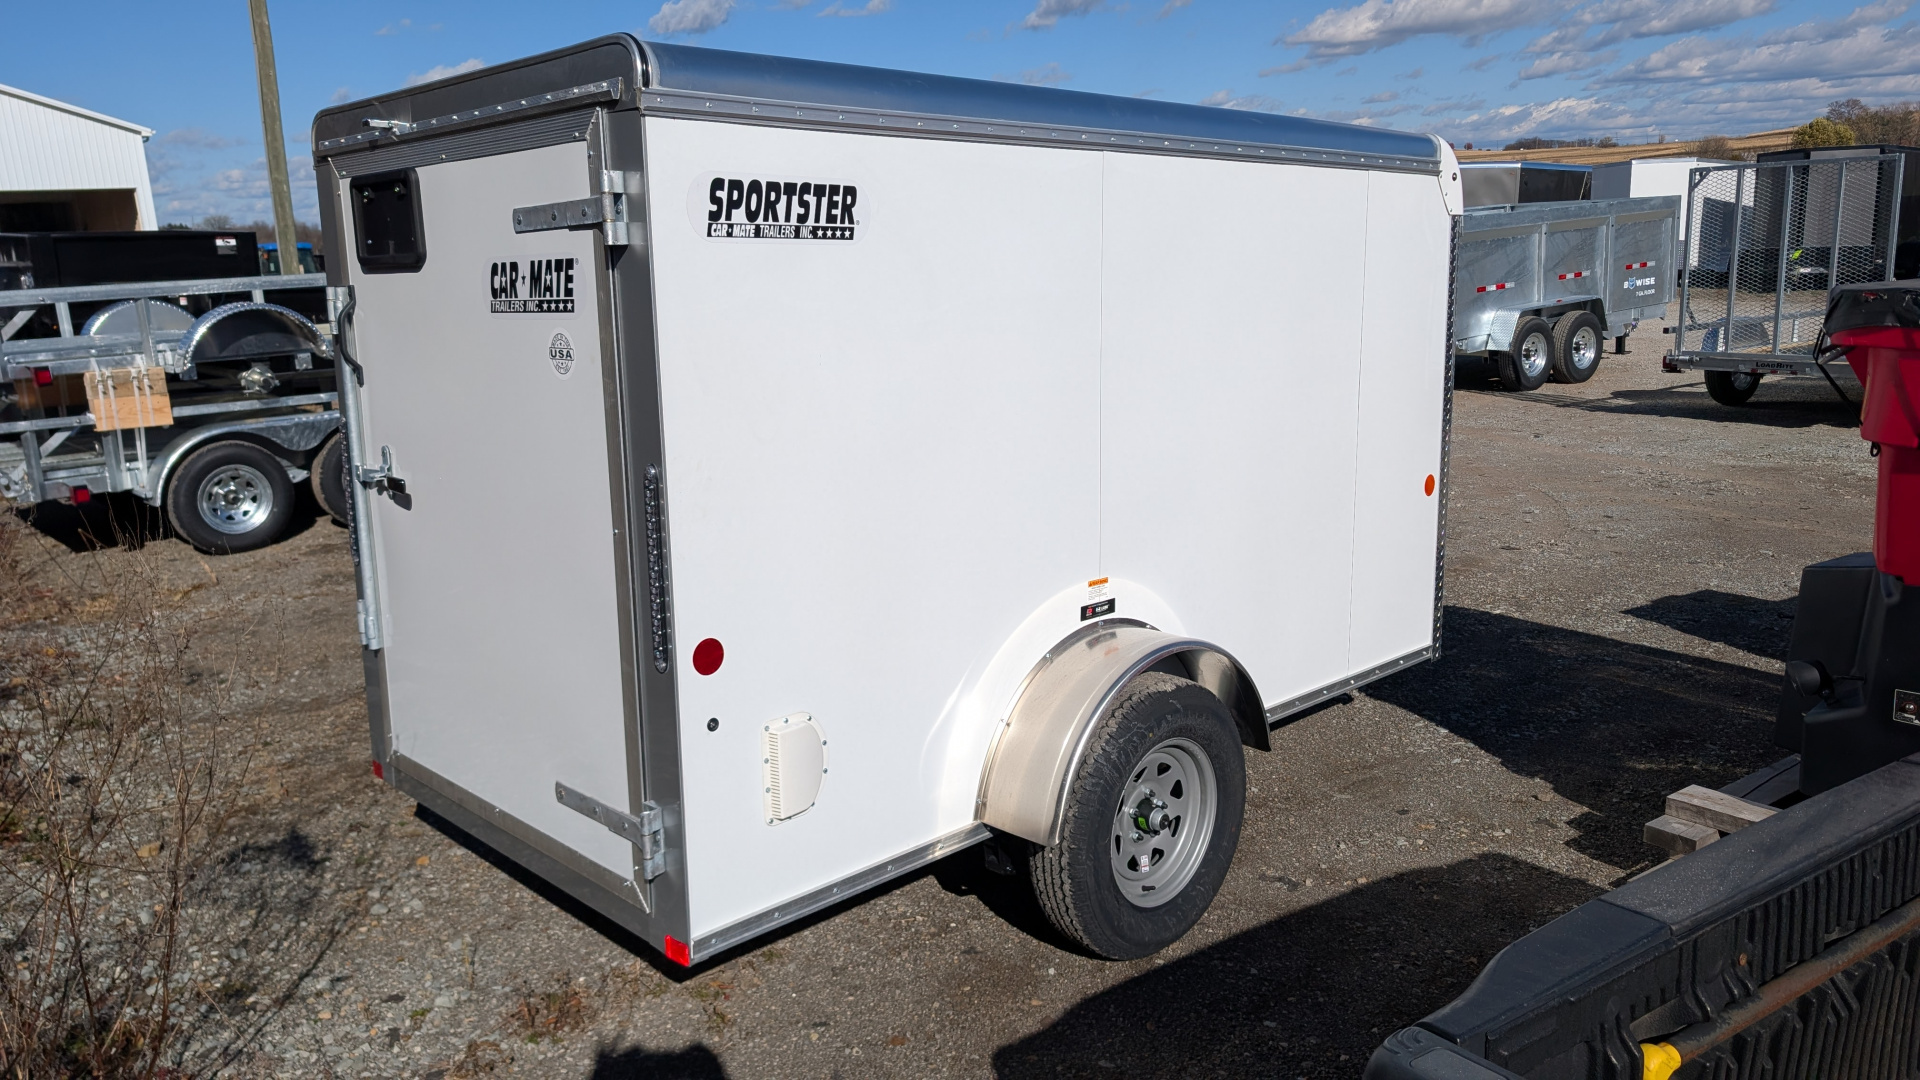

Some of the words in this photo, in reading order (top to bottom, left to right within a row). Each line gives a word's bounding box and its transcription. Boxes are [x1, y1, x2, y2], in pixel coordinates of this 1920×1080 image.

[708, 177, 858, 225] SPORTSTER
[759, 225, 796, 239] TRAILERS
[491, 300, 525, 312] TRAILERS
[550, 349, 573, 360] USA
